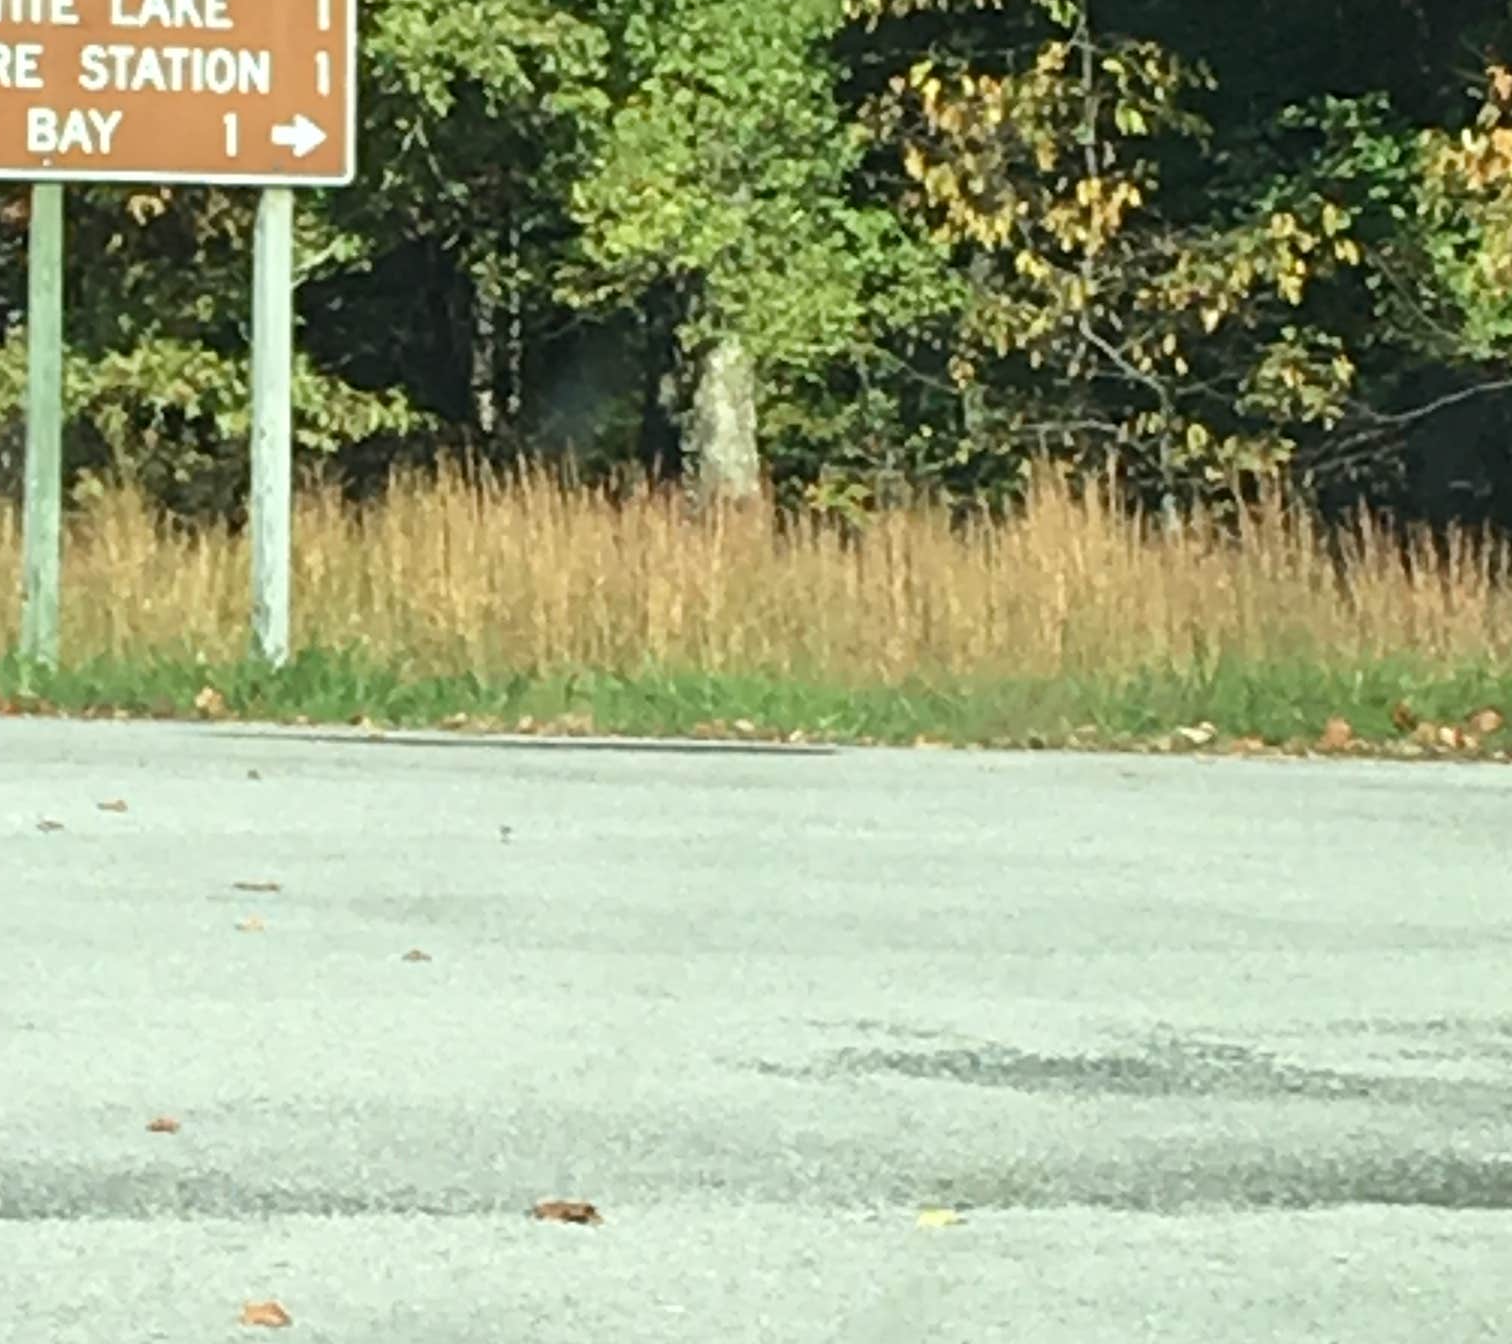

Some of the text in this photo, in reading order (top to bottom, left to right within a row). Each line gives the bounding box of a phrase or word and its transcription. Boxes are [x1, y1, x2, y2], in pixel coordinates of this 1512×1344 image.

[78, 44, 271, 94] STATION
[315, 51, 330, 96] 1
[27, 107, 123, 154] BAY
[223, 112, 238, 157] 1
